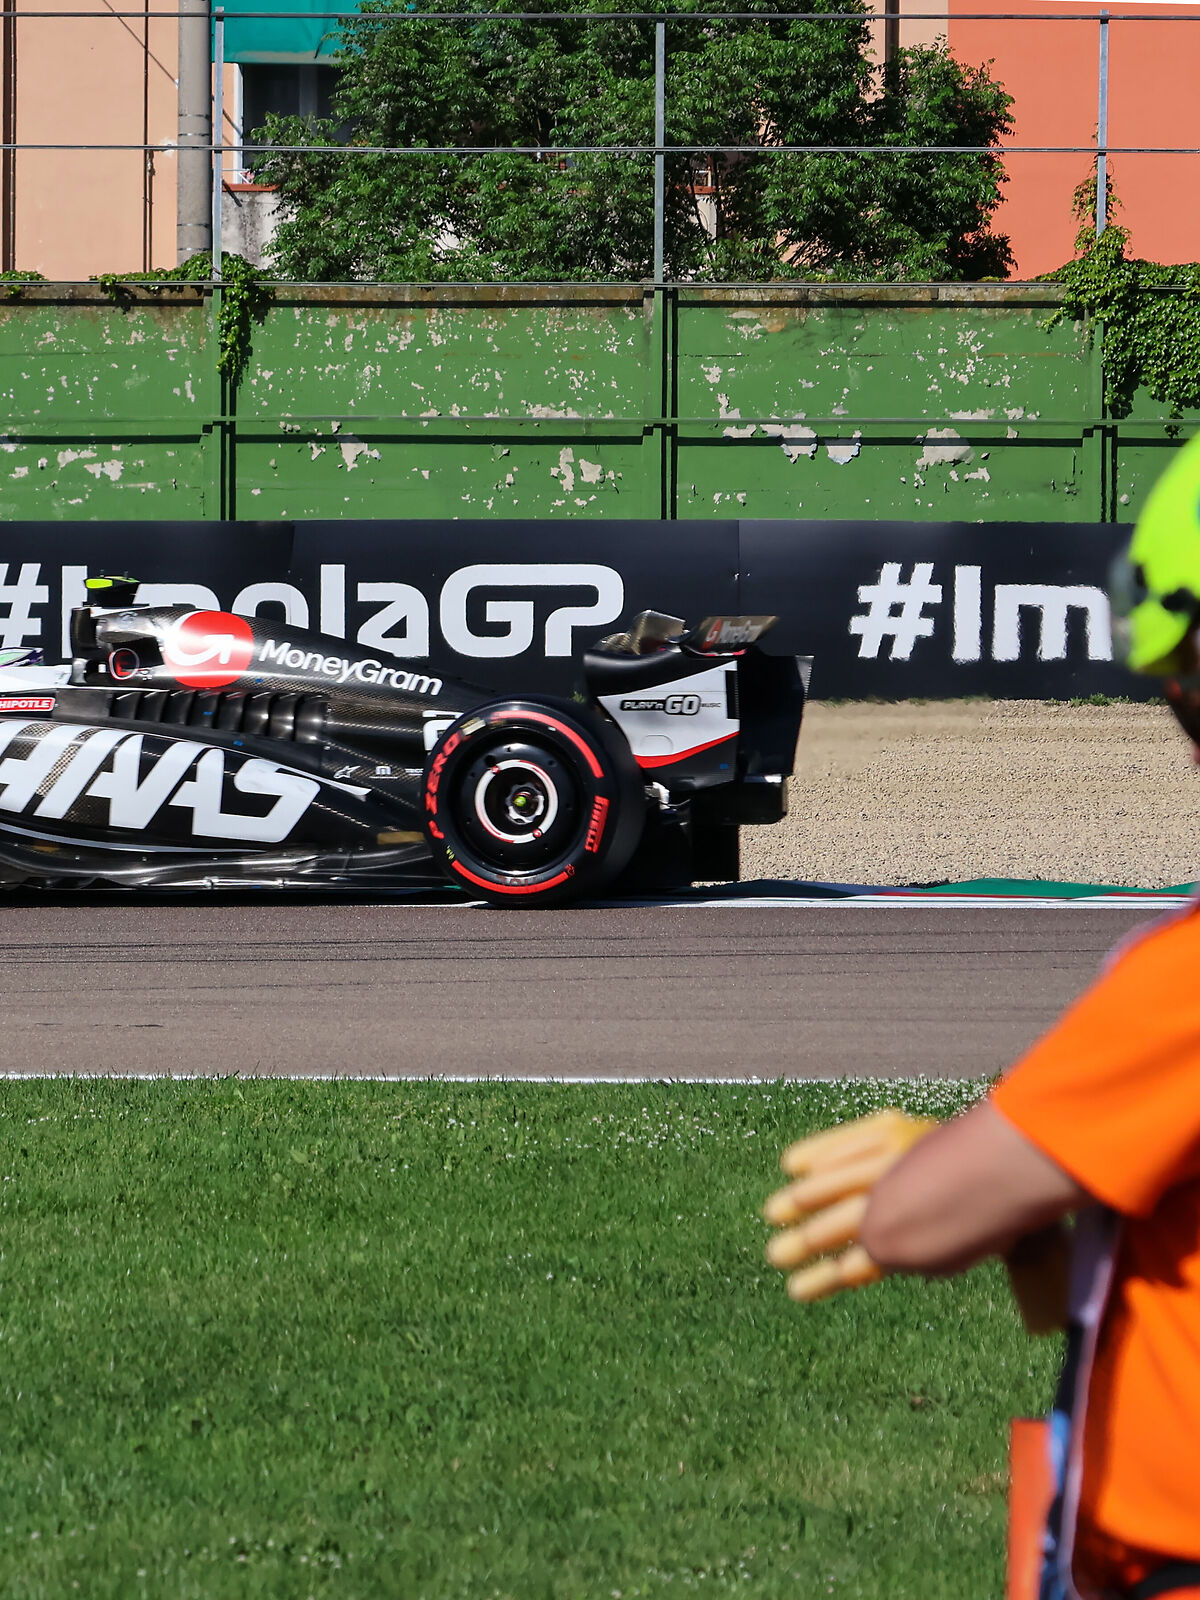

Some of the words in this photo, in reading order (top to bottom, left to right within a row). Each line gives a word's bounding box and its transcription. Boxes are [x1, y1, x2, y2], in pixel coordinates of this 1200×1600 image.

[258, 639, 443, 696] MoneyGram
[665, 695, 701, 715] GO
[425, 731, 461, 815] ZERO
[584, 795, 610, 853] PIRELLI
